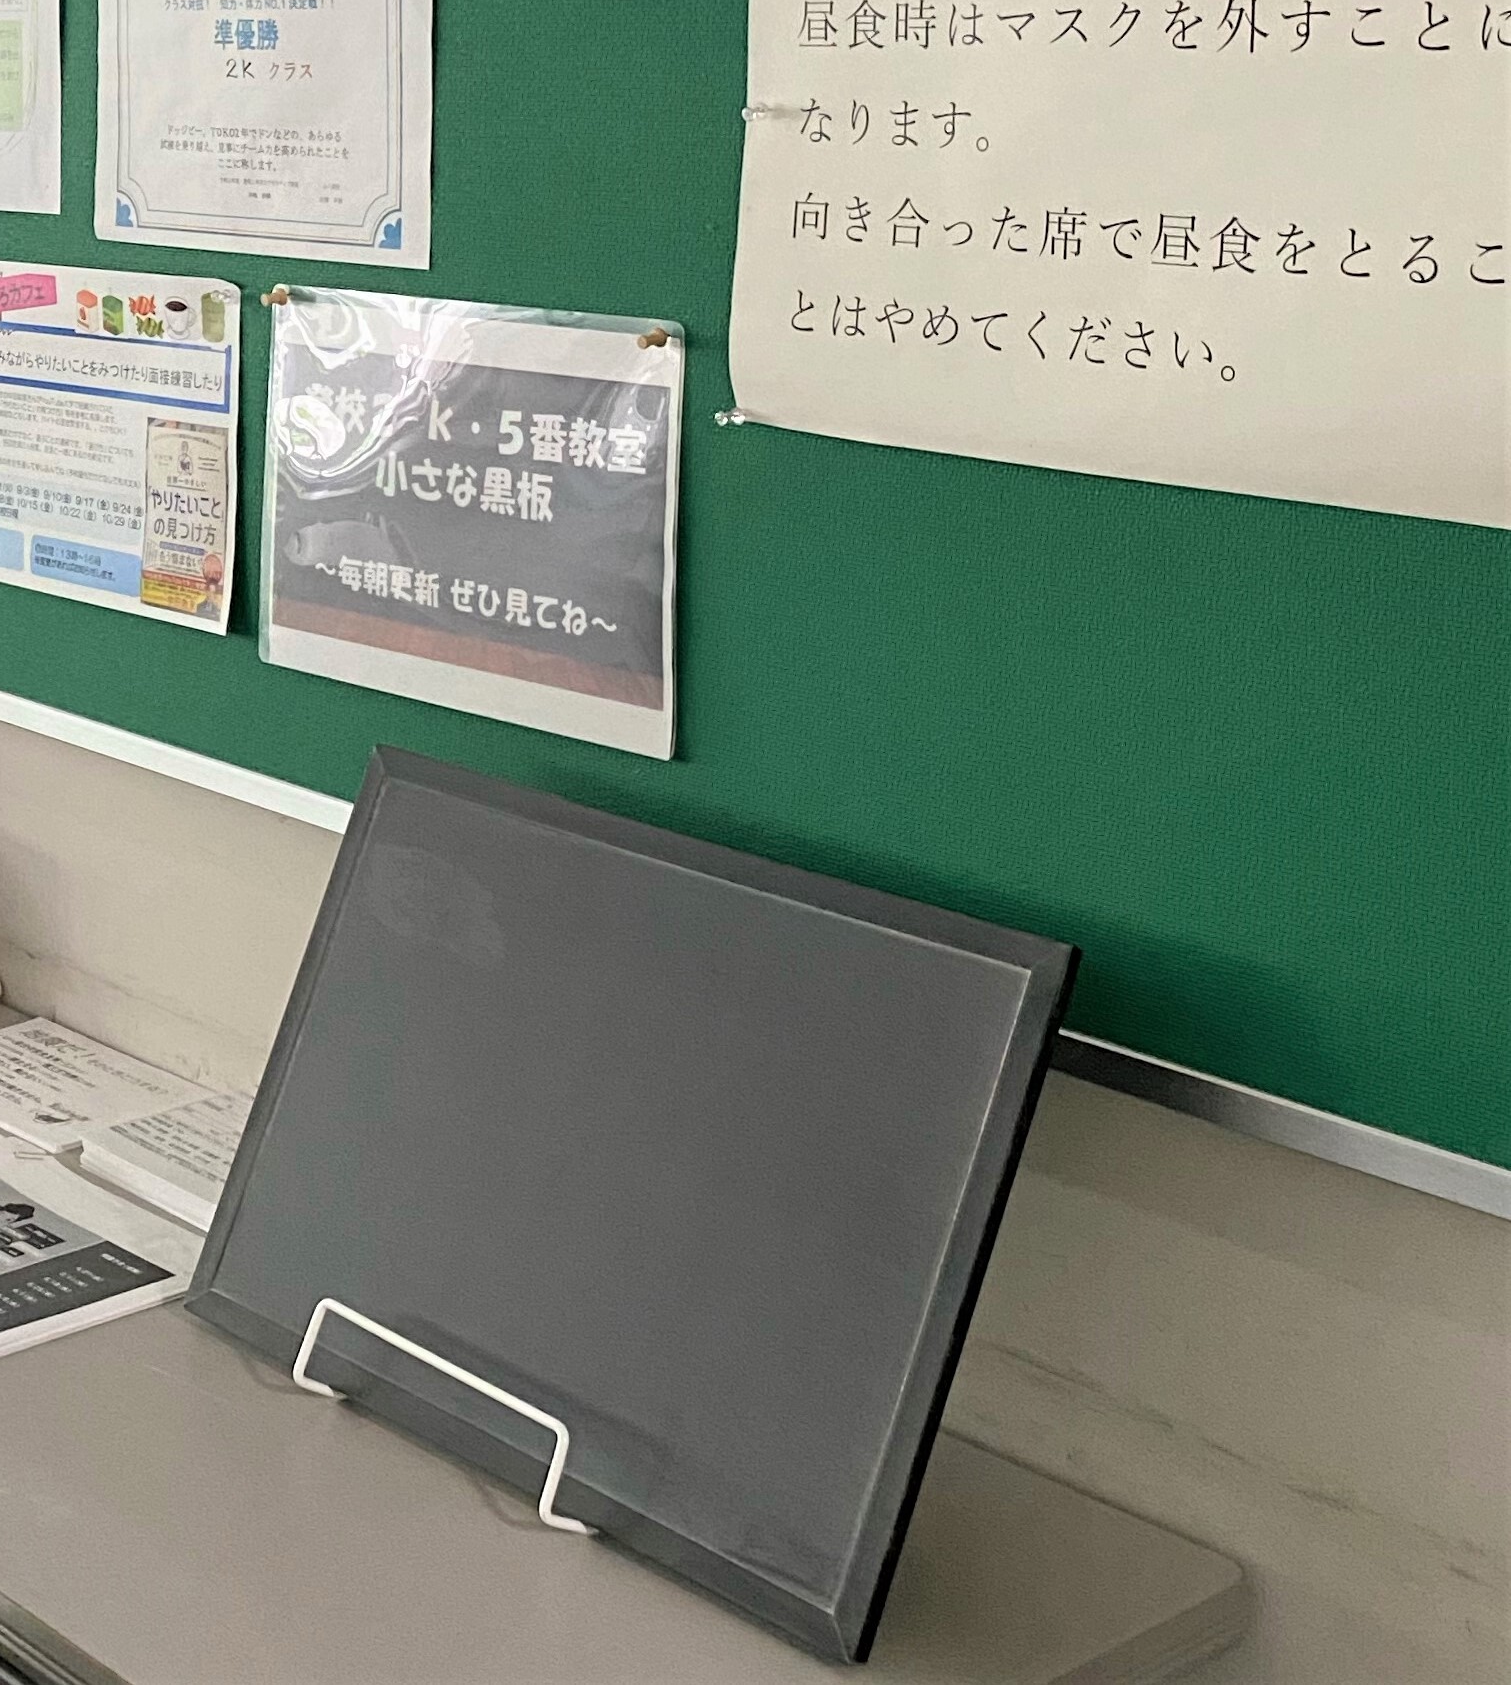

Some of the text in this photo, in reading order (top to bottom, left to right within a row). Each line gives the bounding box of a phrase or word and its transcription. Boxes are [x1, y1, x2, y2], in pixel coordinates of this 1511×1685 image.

[214, 18, 279, 50] 準優勝
[226, 58, 313, 81] 2K クラス
[798, 97, 991, 154] なります。
[791, 191, 1508, 285] 向き合った席で昼食をとるこ
[789, 289, 1237, 383] とはやめてください。
[376, 451, 554, 522] 小さな黒板
[153, 517, 217, 546] の見つけ方
[451, 578, 617, 635] ぜひ見てね〜
